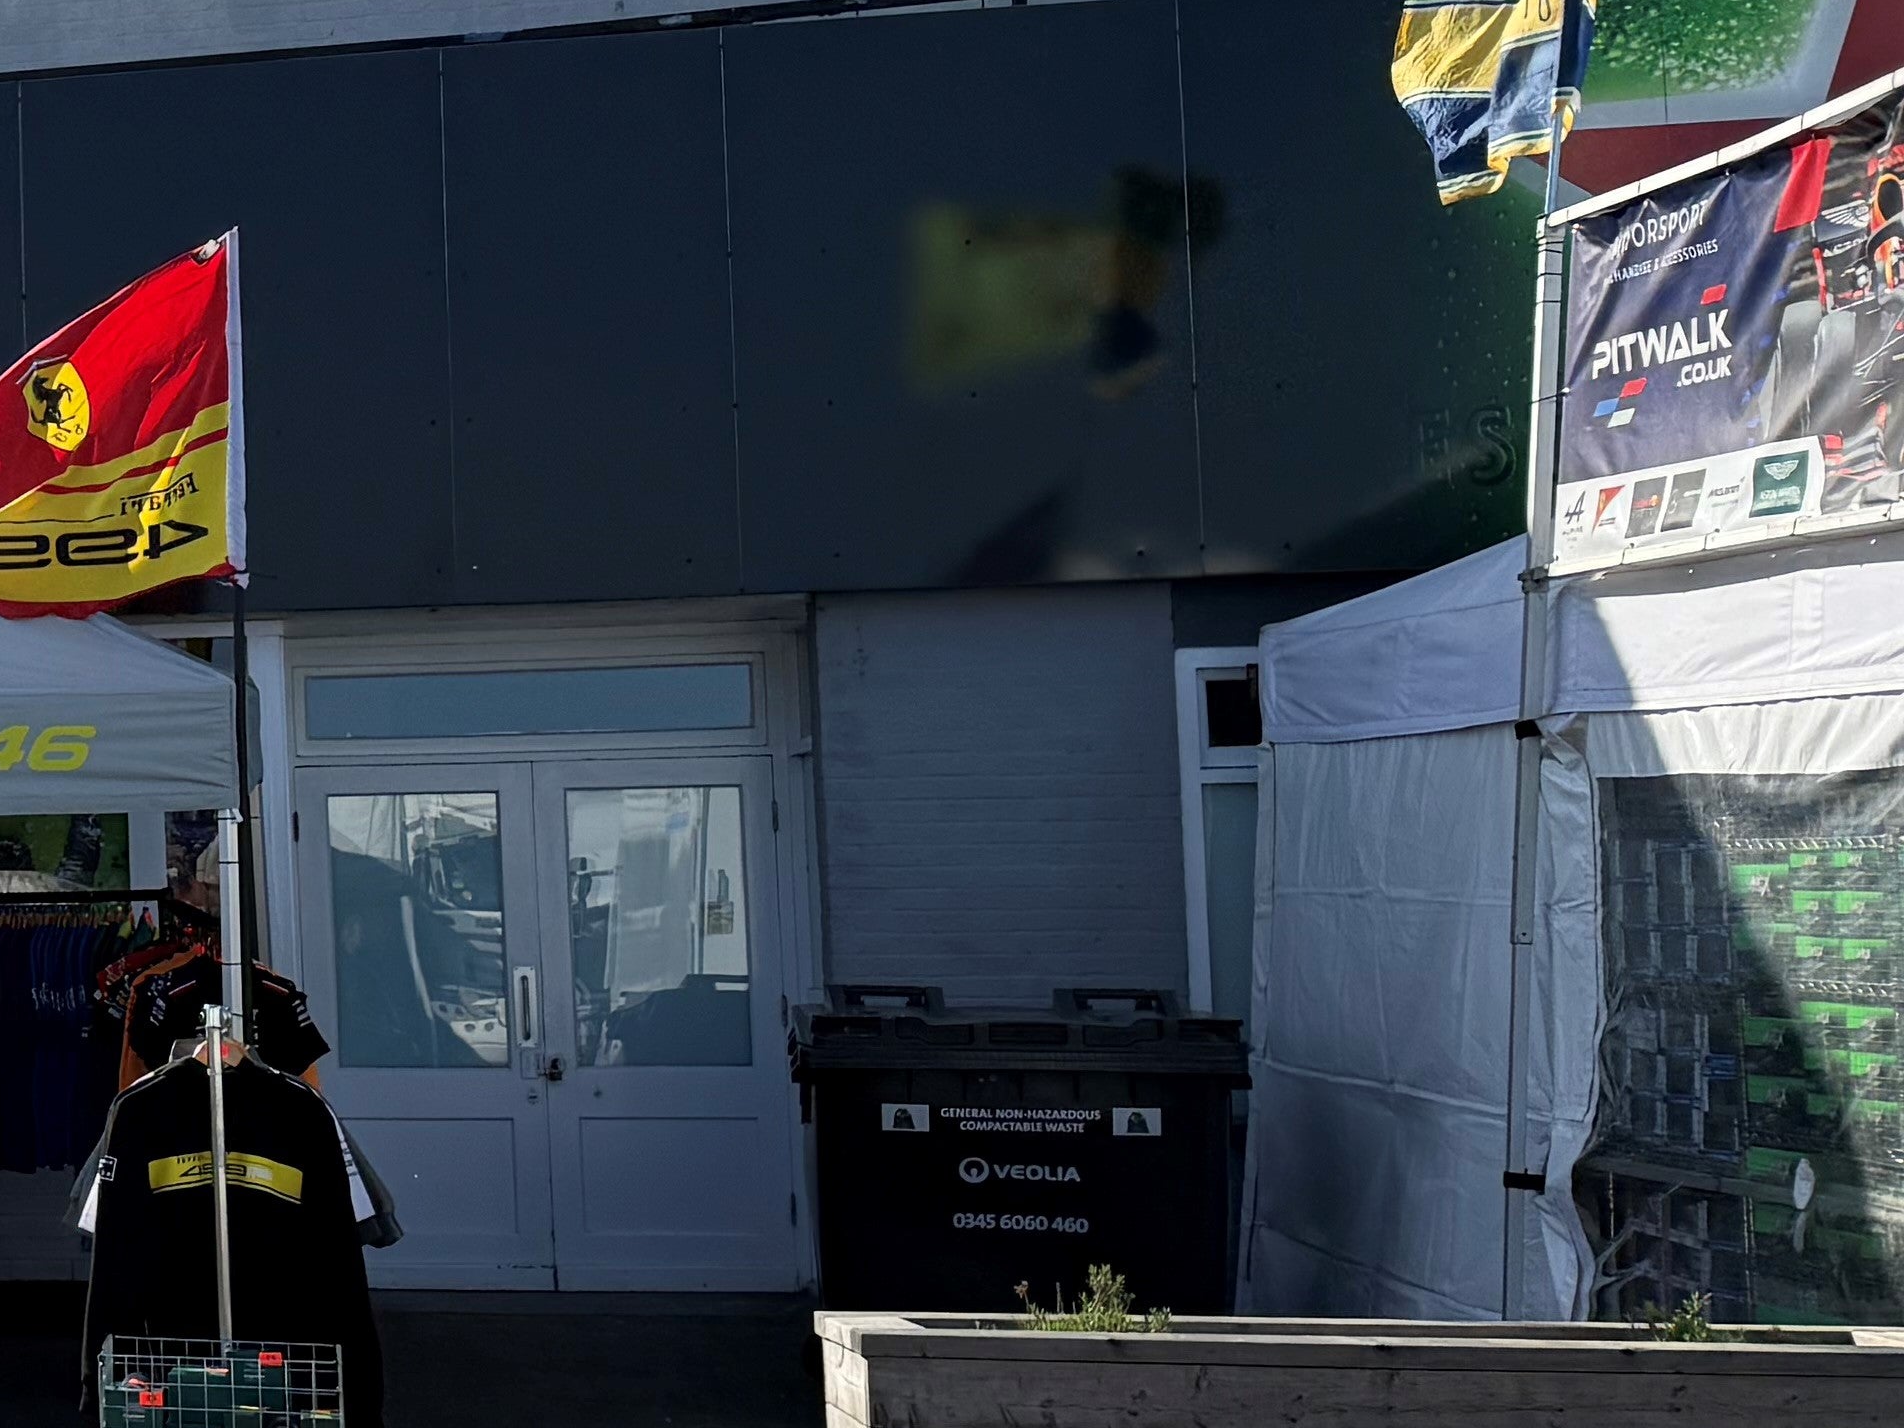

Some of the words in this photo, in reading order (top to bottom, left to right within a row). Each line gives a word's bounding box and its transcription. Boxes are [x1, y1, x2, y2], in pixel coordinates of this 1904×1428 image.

[1591, 308, 1733, 381] PITWALK
[940, 1107, 993, 1119] GENERAL
[995, 1108, 1102, 1121] NON-HAZARDOUS
[959, 1120, 1044, 1133] COMPACTABLE
[1045, 1122, 1085, 1134] WASTE
[993, 1164, 1081, 1183] VEOLIA
[952, 1212, 997, 1230] 0345
[999, 1213, 1049, 1232] 6060
[1050, 1216, 1090, 1234] 460
